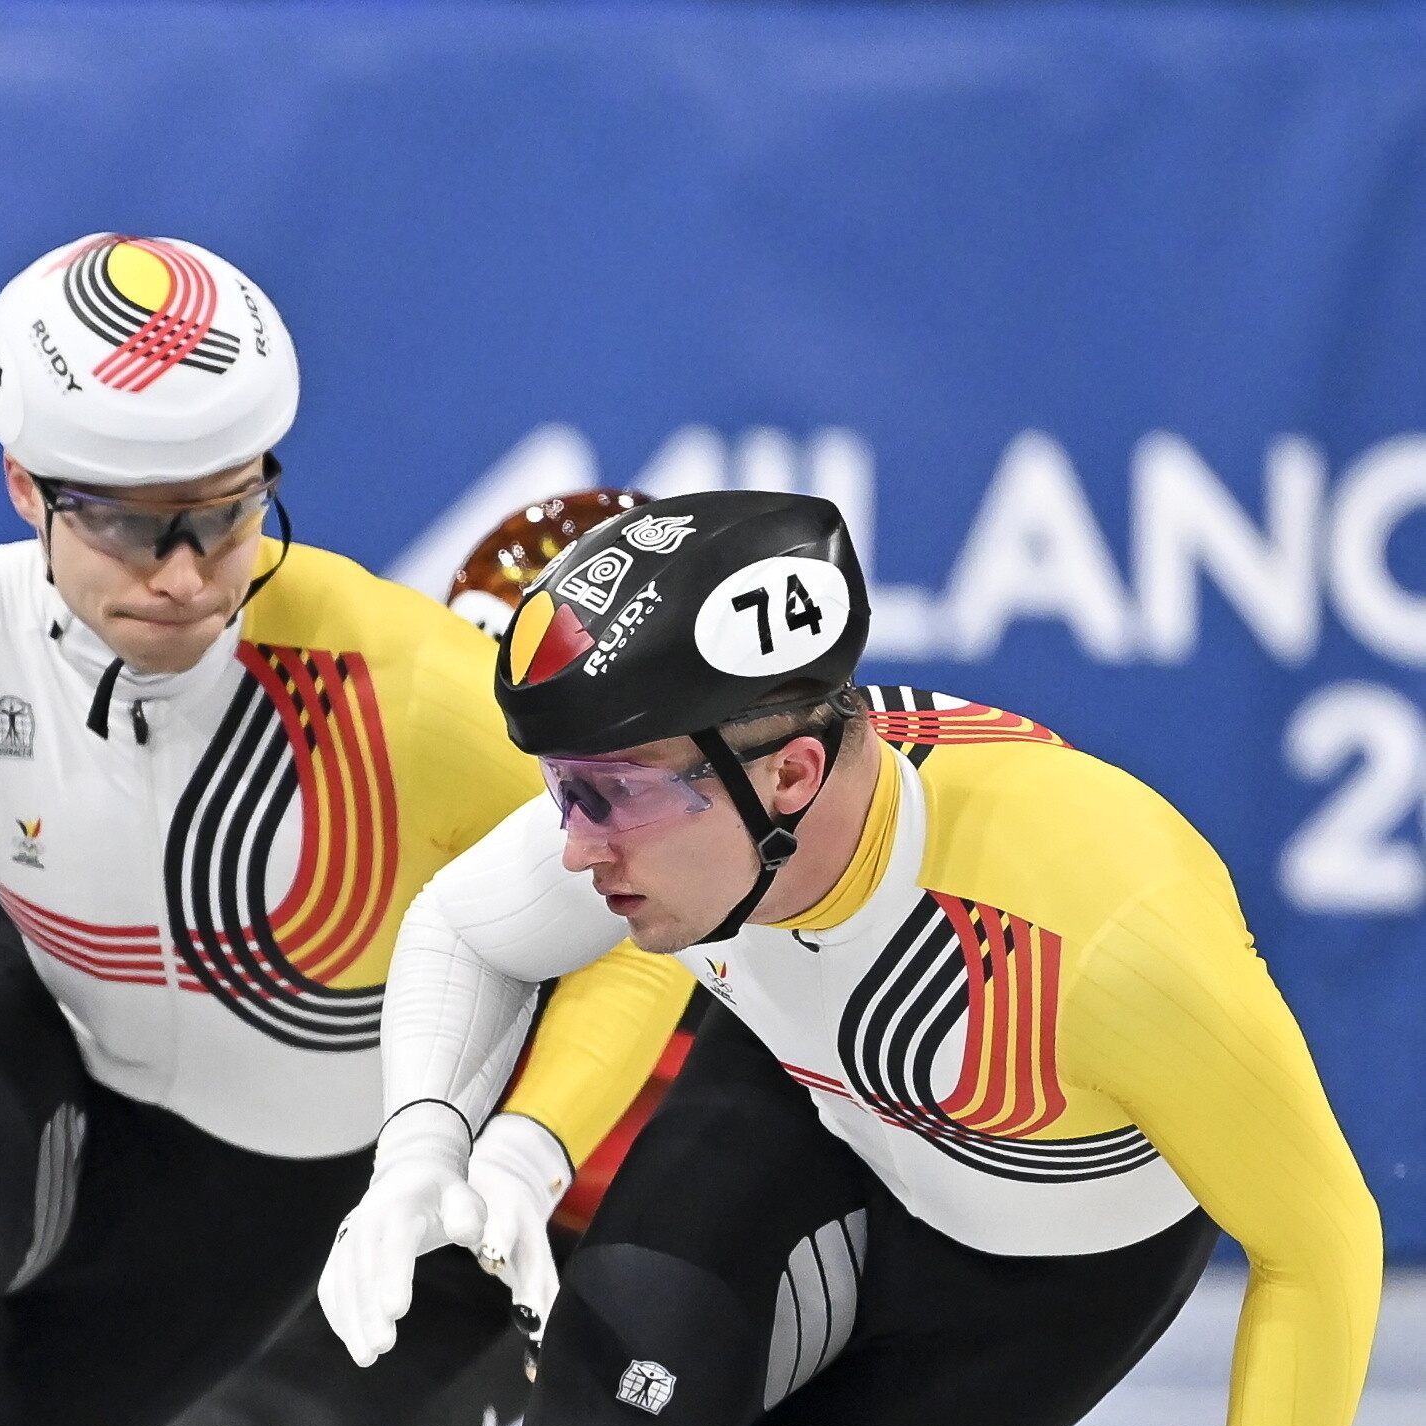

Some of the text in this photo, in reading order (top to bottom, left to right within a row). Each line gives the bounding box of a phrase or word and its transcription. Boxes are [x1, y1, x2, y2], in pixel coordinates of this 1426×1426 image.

[31, 318, 83, 391] RUDY
[235, 279, 267, 357] RUDY
[583, 580, 657, 677] RUDY
[600, 594, 663, 674] PROJECT
[731, 573, 823, 655] 74
